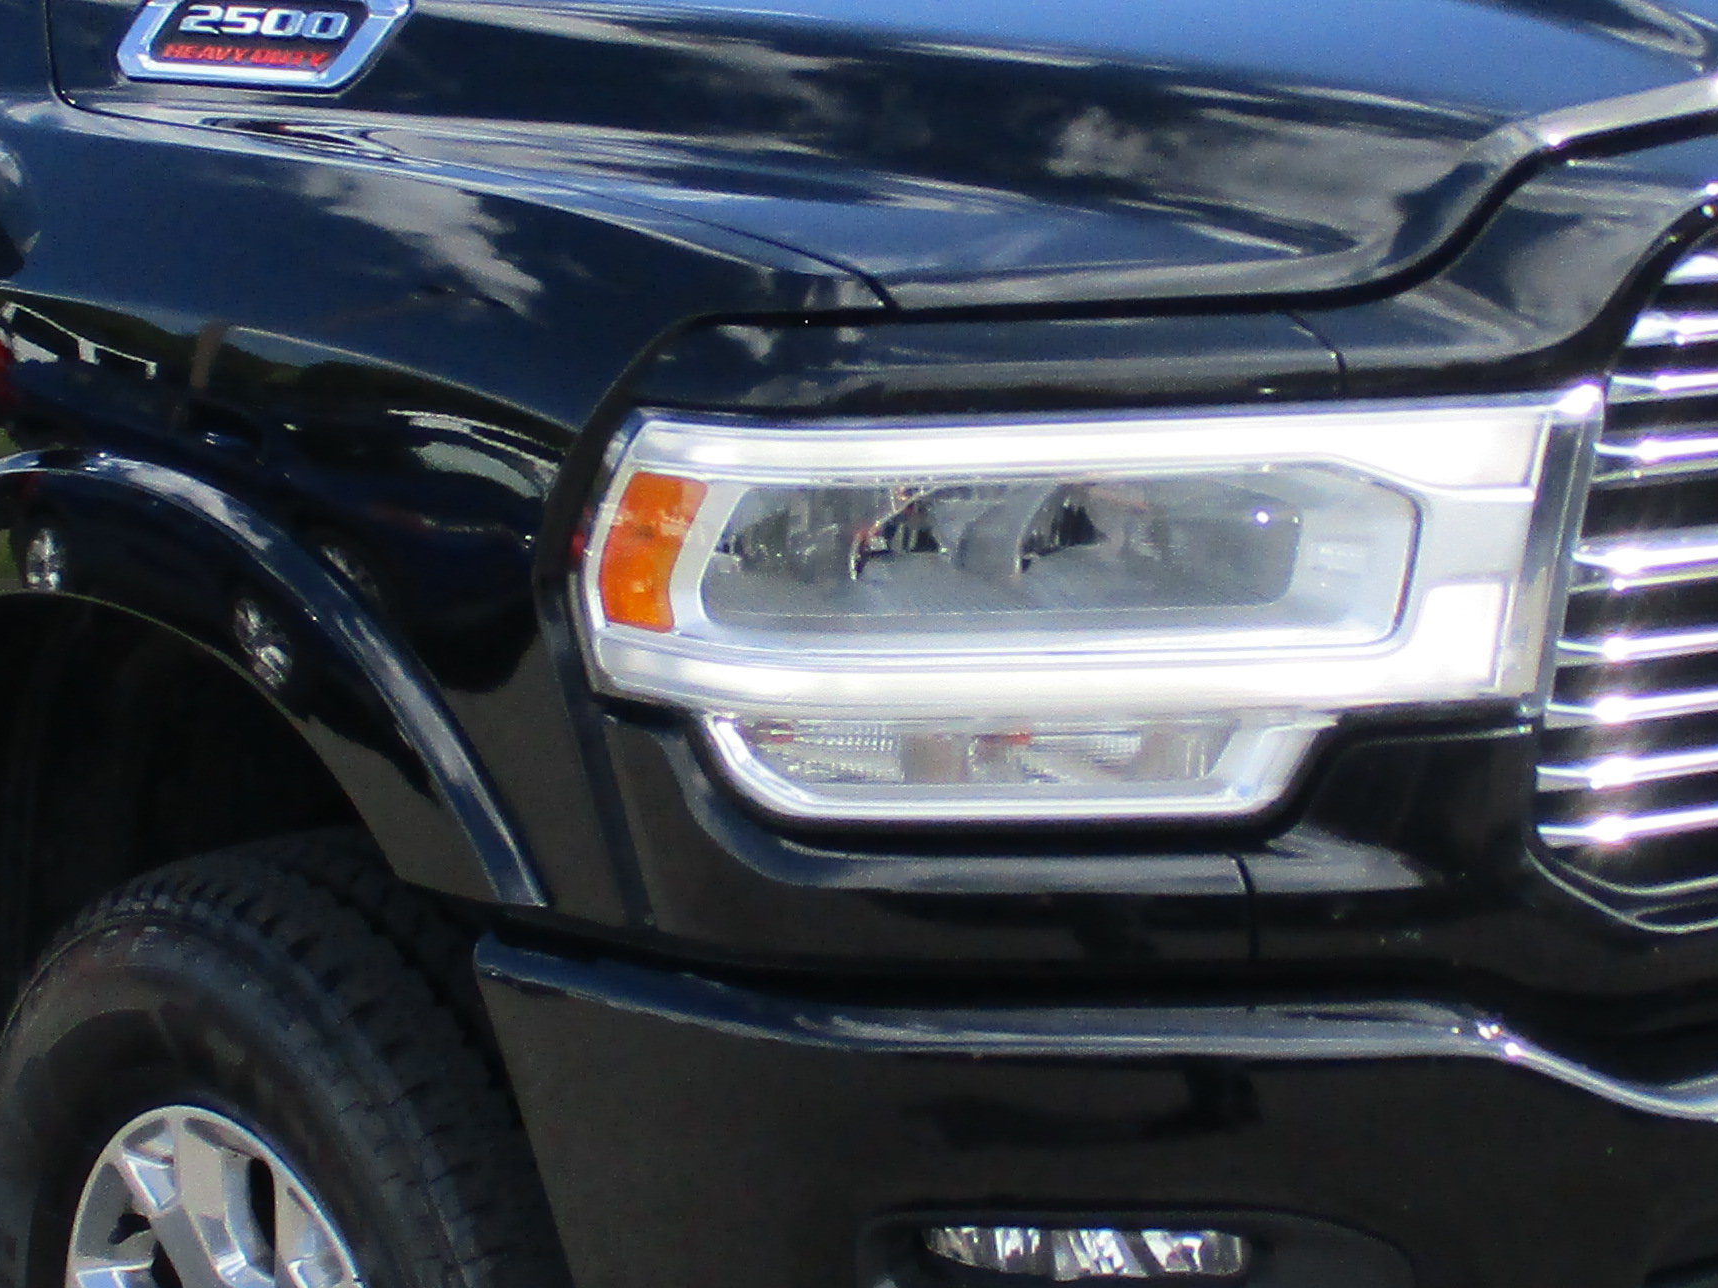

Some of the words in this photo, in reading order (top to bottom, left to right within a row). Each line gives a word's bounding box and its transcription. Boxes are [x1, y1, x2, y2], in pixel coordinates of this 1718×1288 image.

[178, 4, 349, 40] 2500
[162, 43, 250, 63] HEAVY
[249, 48, 329, 68] DUTY
